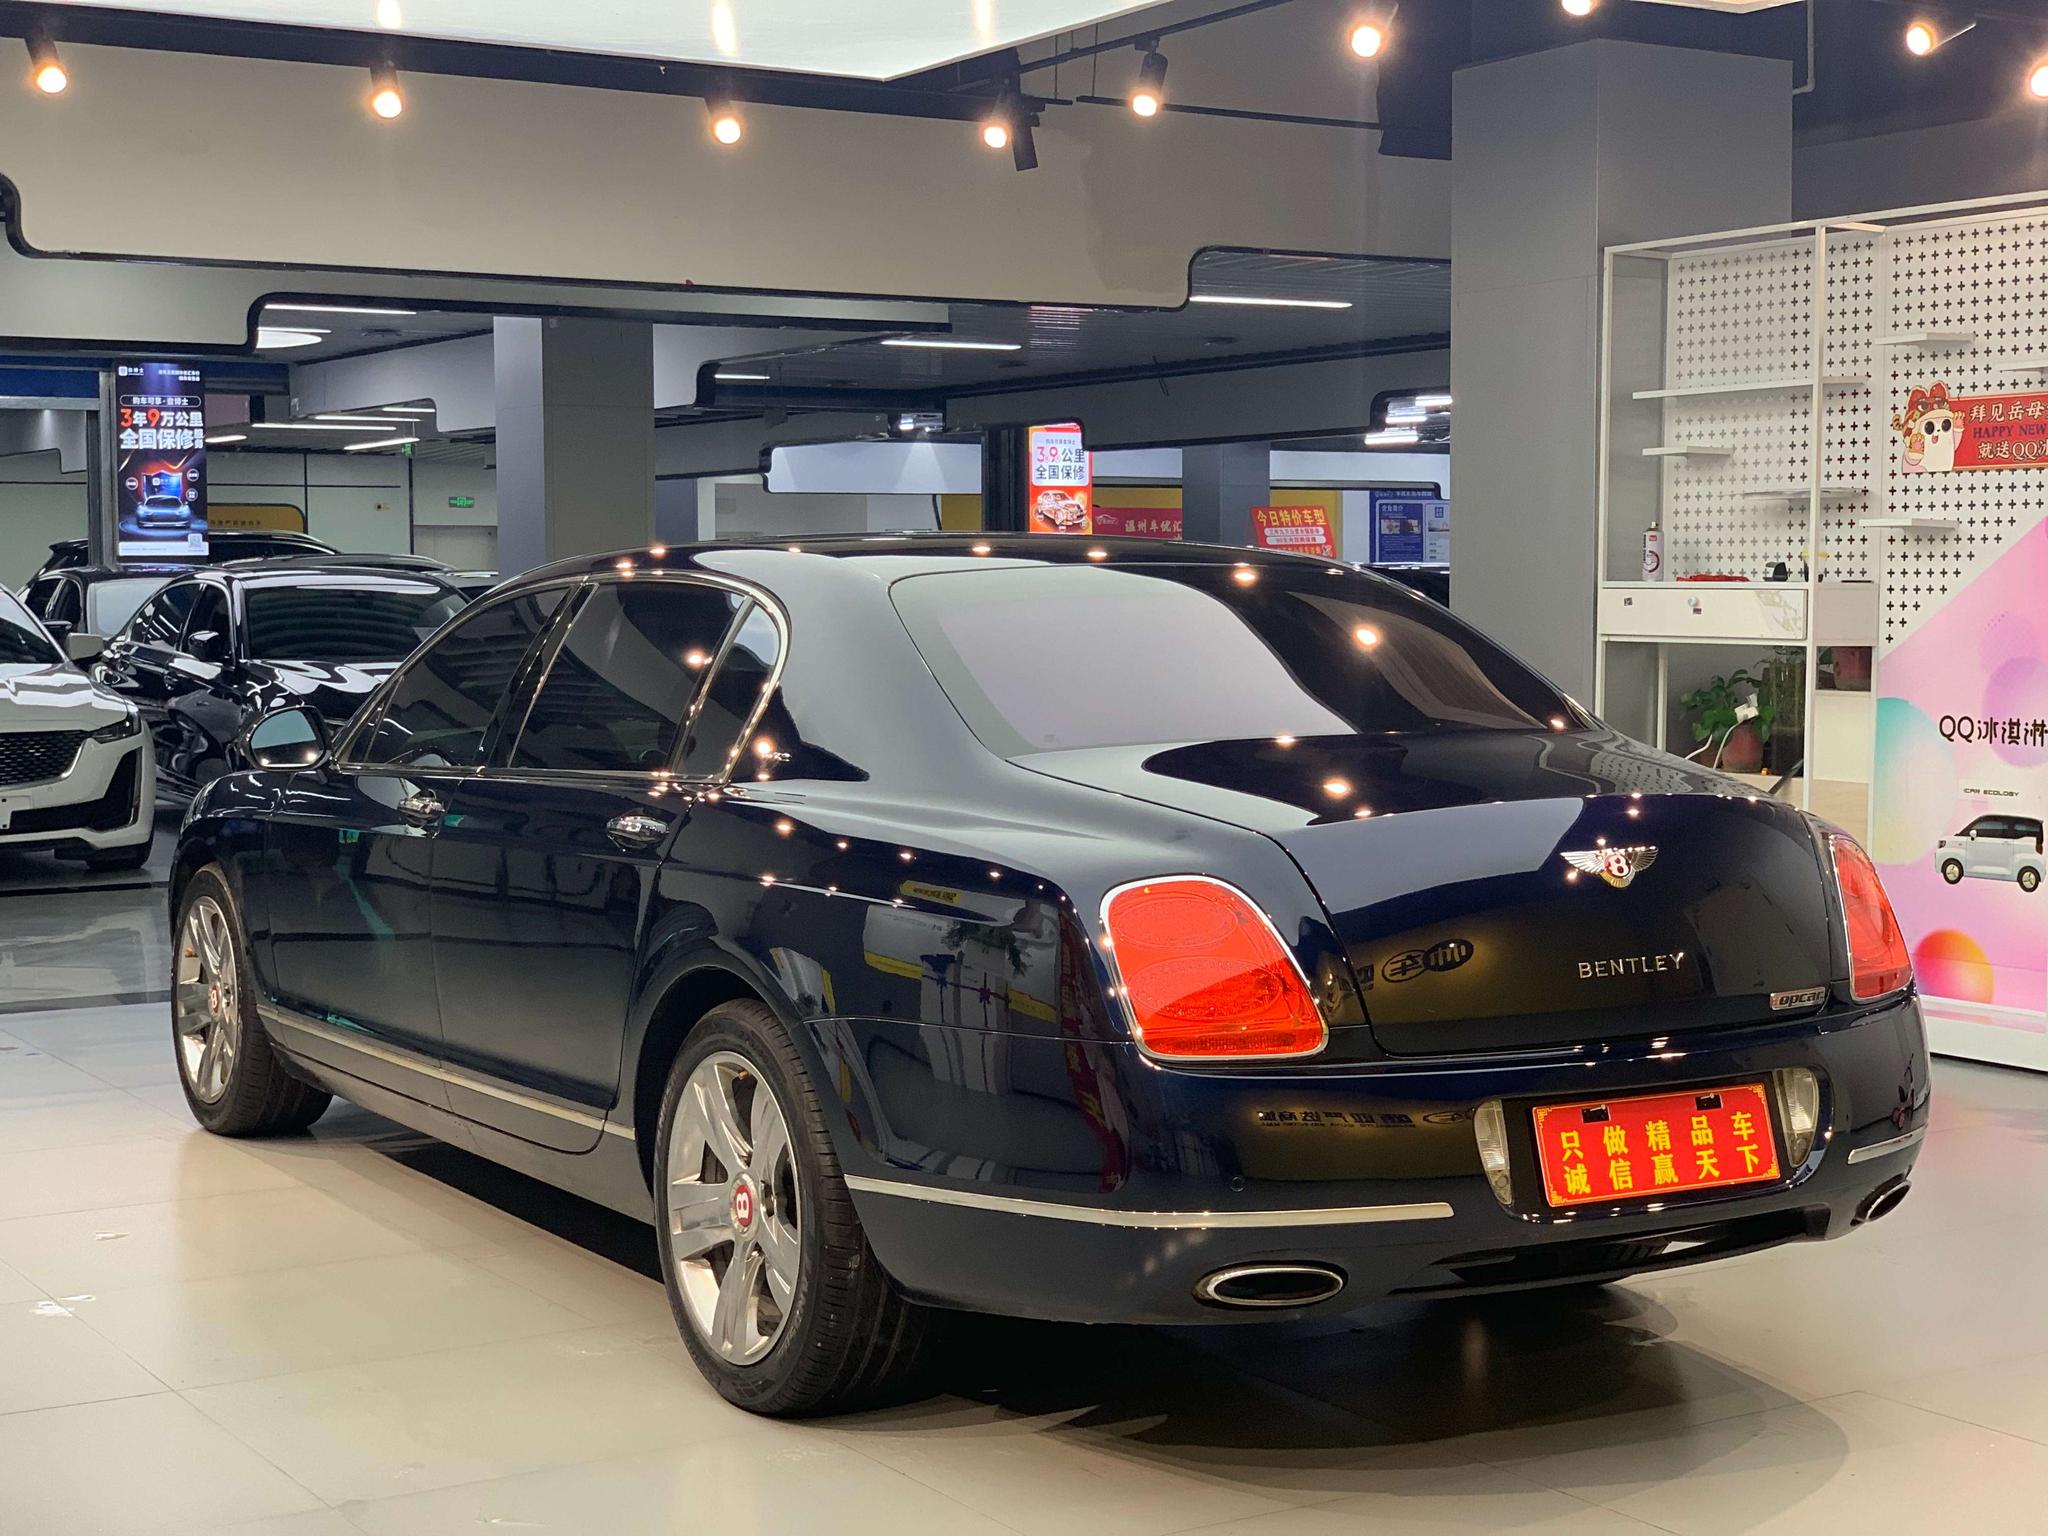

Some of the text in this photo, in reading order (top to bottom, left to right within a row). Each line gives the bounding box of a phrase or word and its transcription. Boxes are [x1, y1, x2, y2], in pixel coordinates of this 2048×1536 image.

[120, 408, 204, 427] 3年9万公里
[1969, 400, 2048, 423] 拜见岳母
[1973, 423, 2047, 438] HAPPY NEW
[1035, 465, 1085, 480] 全国保修
[1257, 509, 1327, 526] 今日特价车型
[1939, 715, 2048, 747] QQ冰淇淋
[1578, 952, 1684, 979] BENTLEY
[1560, 1111, 1756, 1162] 只做精品车
[1564, 1144, 1759, 1196] 诚信赢天下
